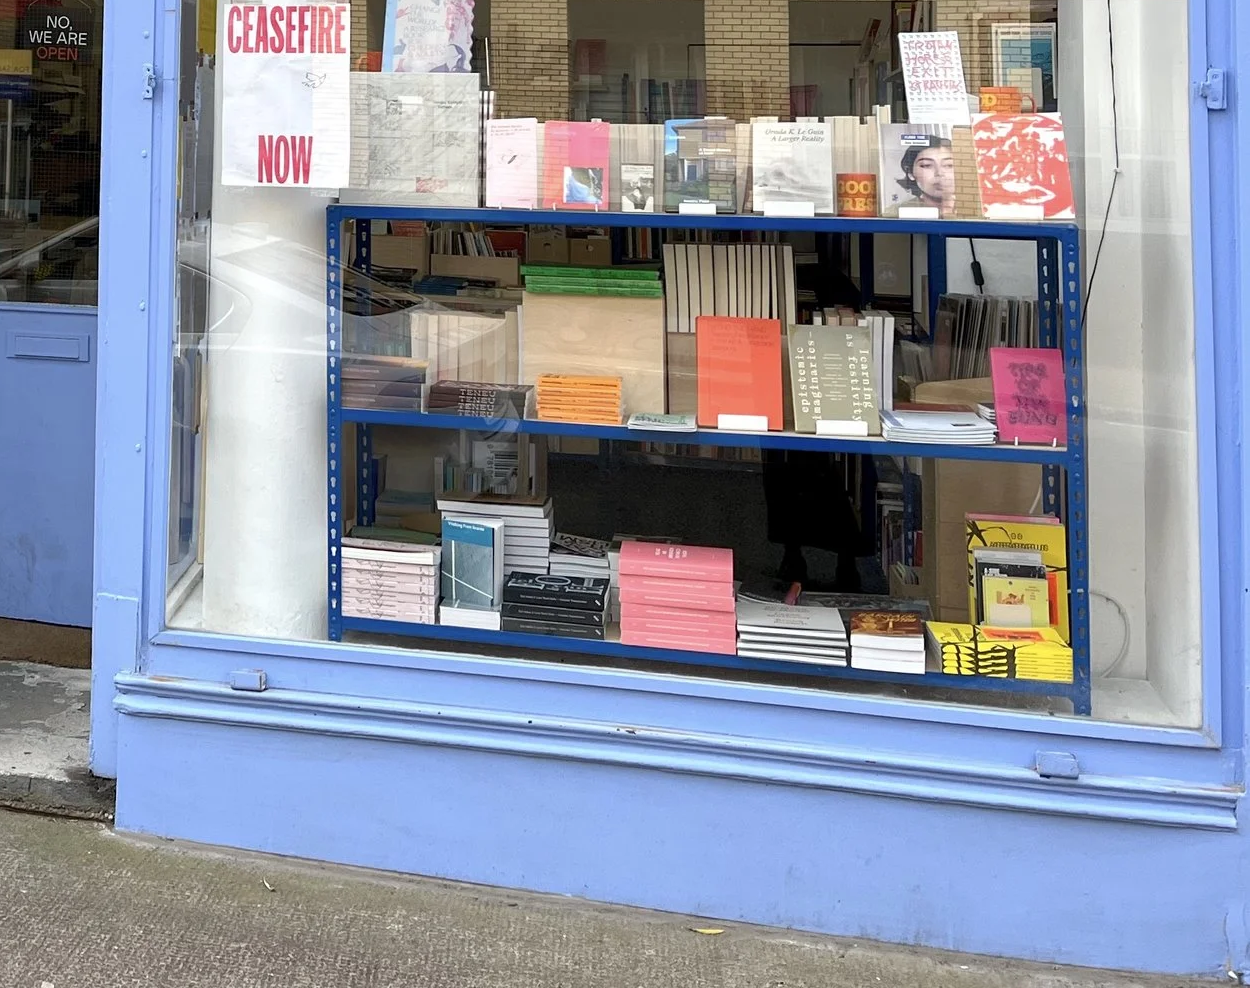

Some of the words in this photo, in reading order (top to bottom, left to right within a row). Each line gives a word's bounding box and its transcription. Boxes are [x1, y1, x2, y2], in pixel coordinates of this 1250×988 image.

[29, 30, 53, 44] WE
[56, 32, 88, 46] ARE
[46, 15, 73, 31] NO,
[228, 5, 347, 55] CEASEFIRE
[36, 46, 79, 61] OPEN
[257, 135, 314, 185] NOW
[845, 333, 854, 348] as
[795, 347, 811, 413] epistemic
[848, 356, 863, 422] festivity
[859, 350, 874, 408] learning
